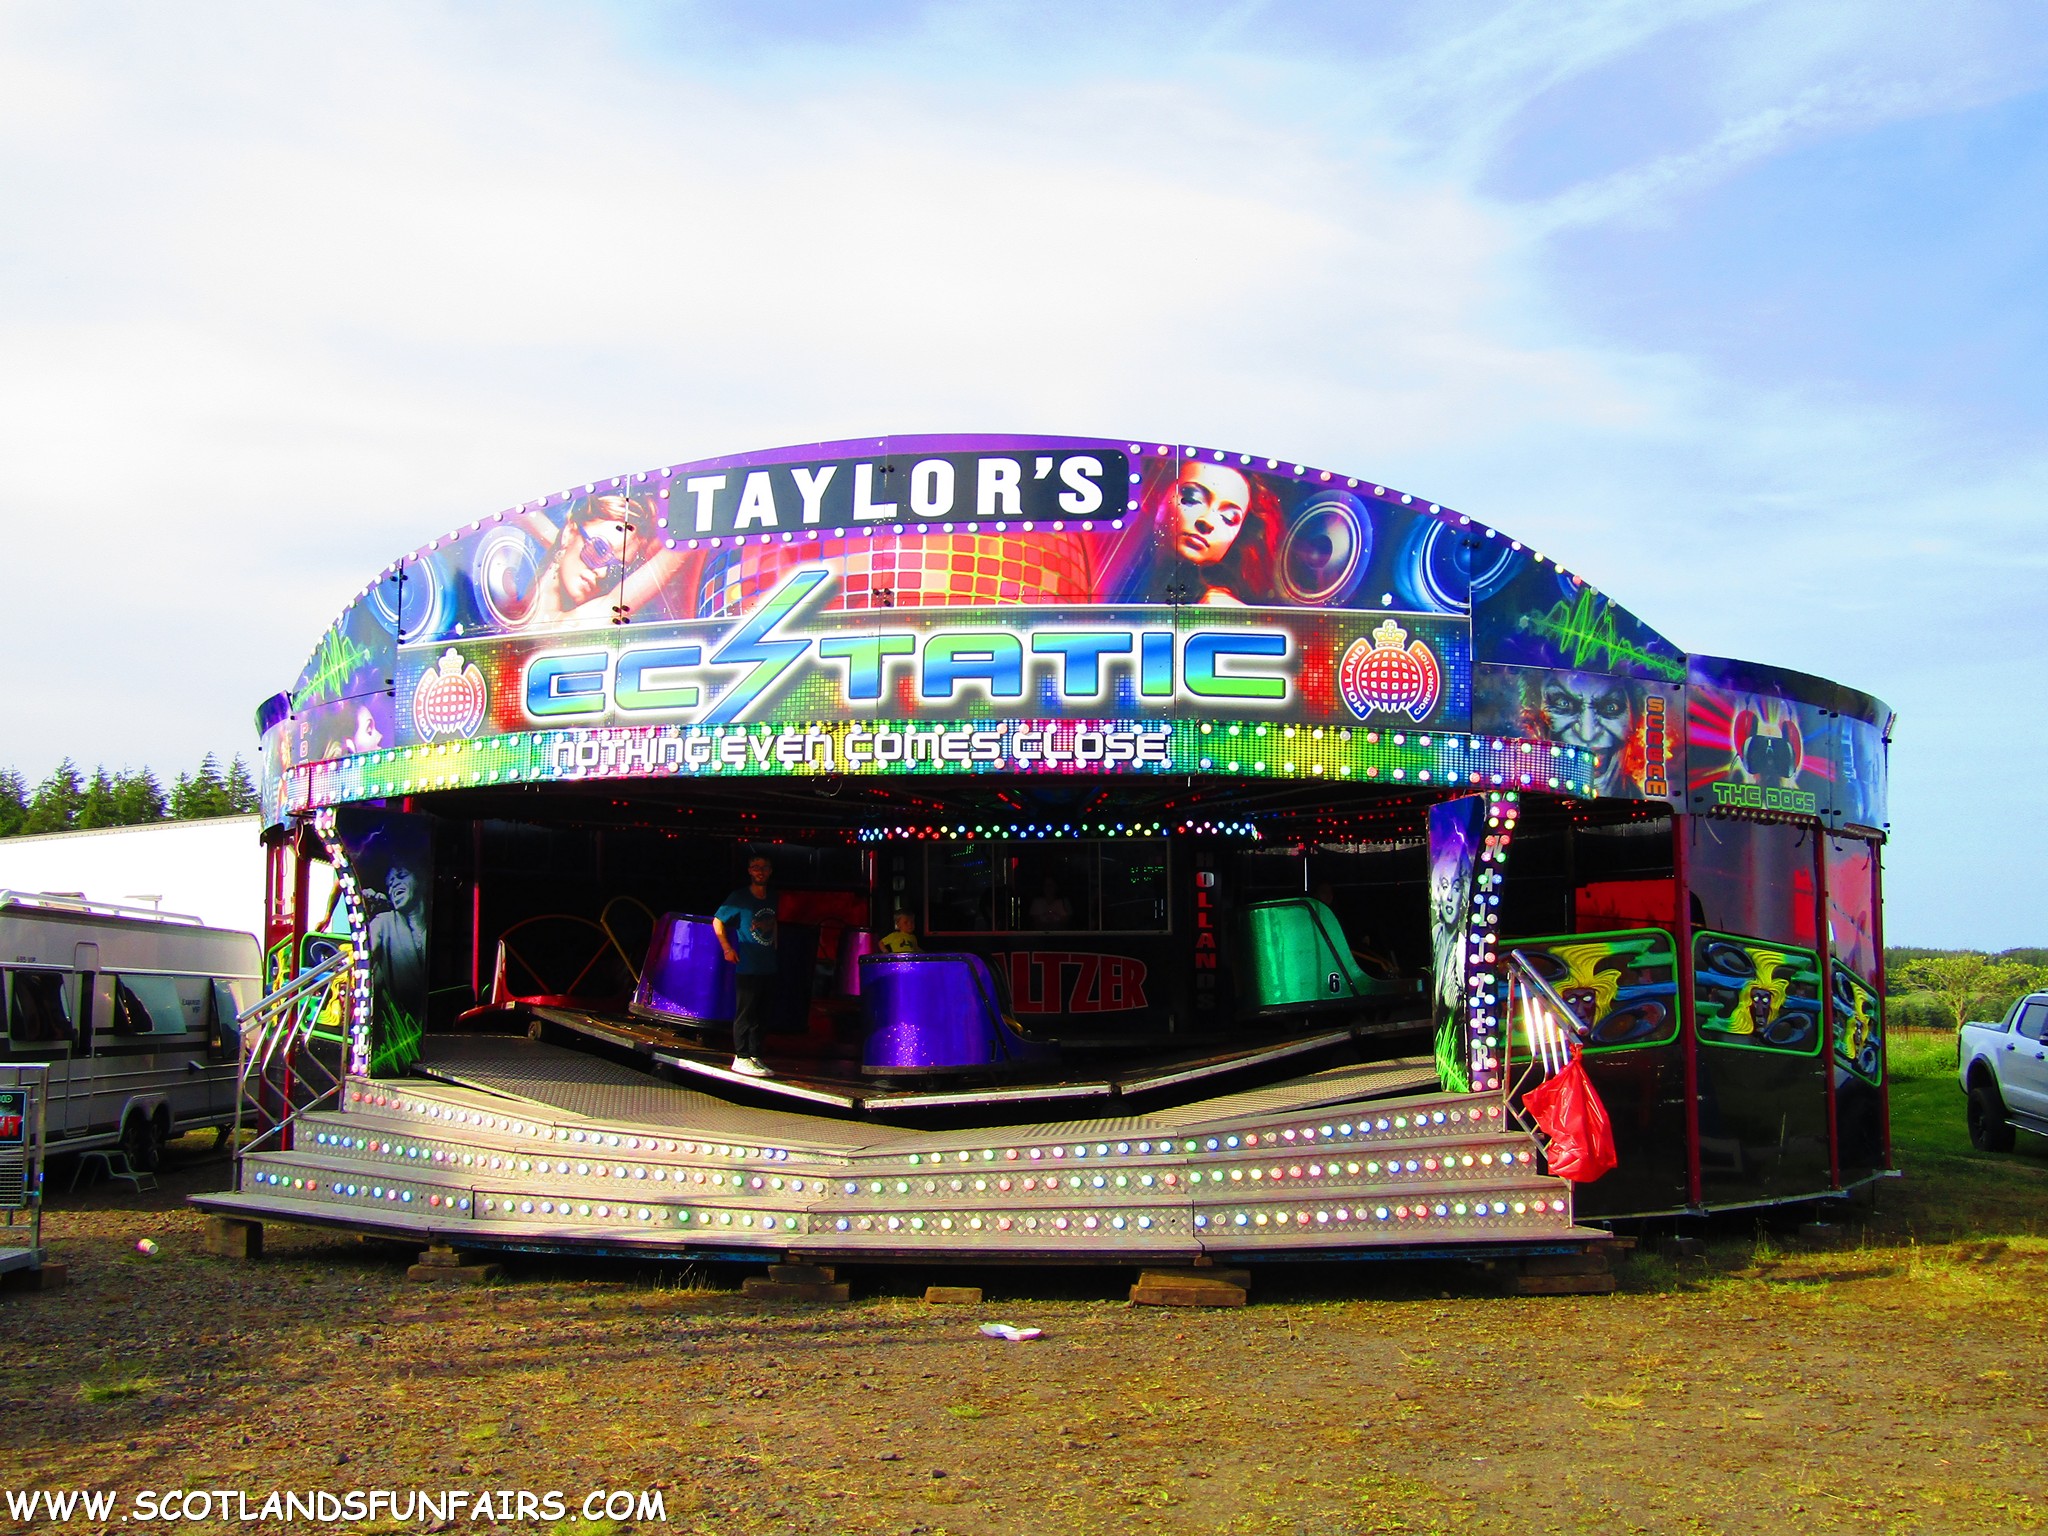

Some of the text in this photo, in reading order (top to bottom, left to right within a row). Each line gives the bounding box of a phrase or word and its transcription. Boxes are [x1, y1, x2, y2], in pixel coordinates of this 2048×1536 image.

[687, 456, 1104, 532] TAYLOR'S
[525, 568, 1288, 724] ECSTATIC
[416, 674, 436, 737] HOLLAND
[465, 671, 483, 733] CORPORATION
[1344, 645, 1366, 713] HOLLAND
[1413, 647, 1435, 715] CORPORATION
[552, 730, 1167, 767] NOTHING EVEN COMES CLOSE
[1645, 696, 1668, 797] SCREAM
[1712, 781, 1816, 813] THE DOGS
[1328, 972, 1341, 994] 6
